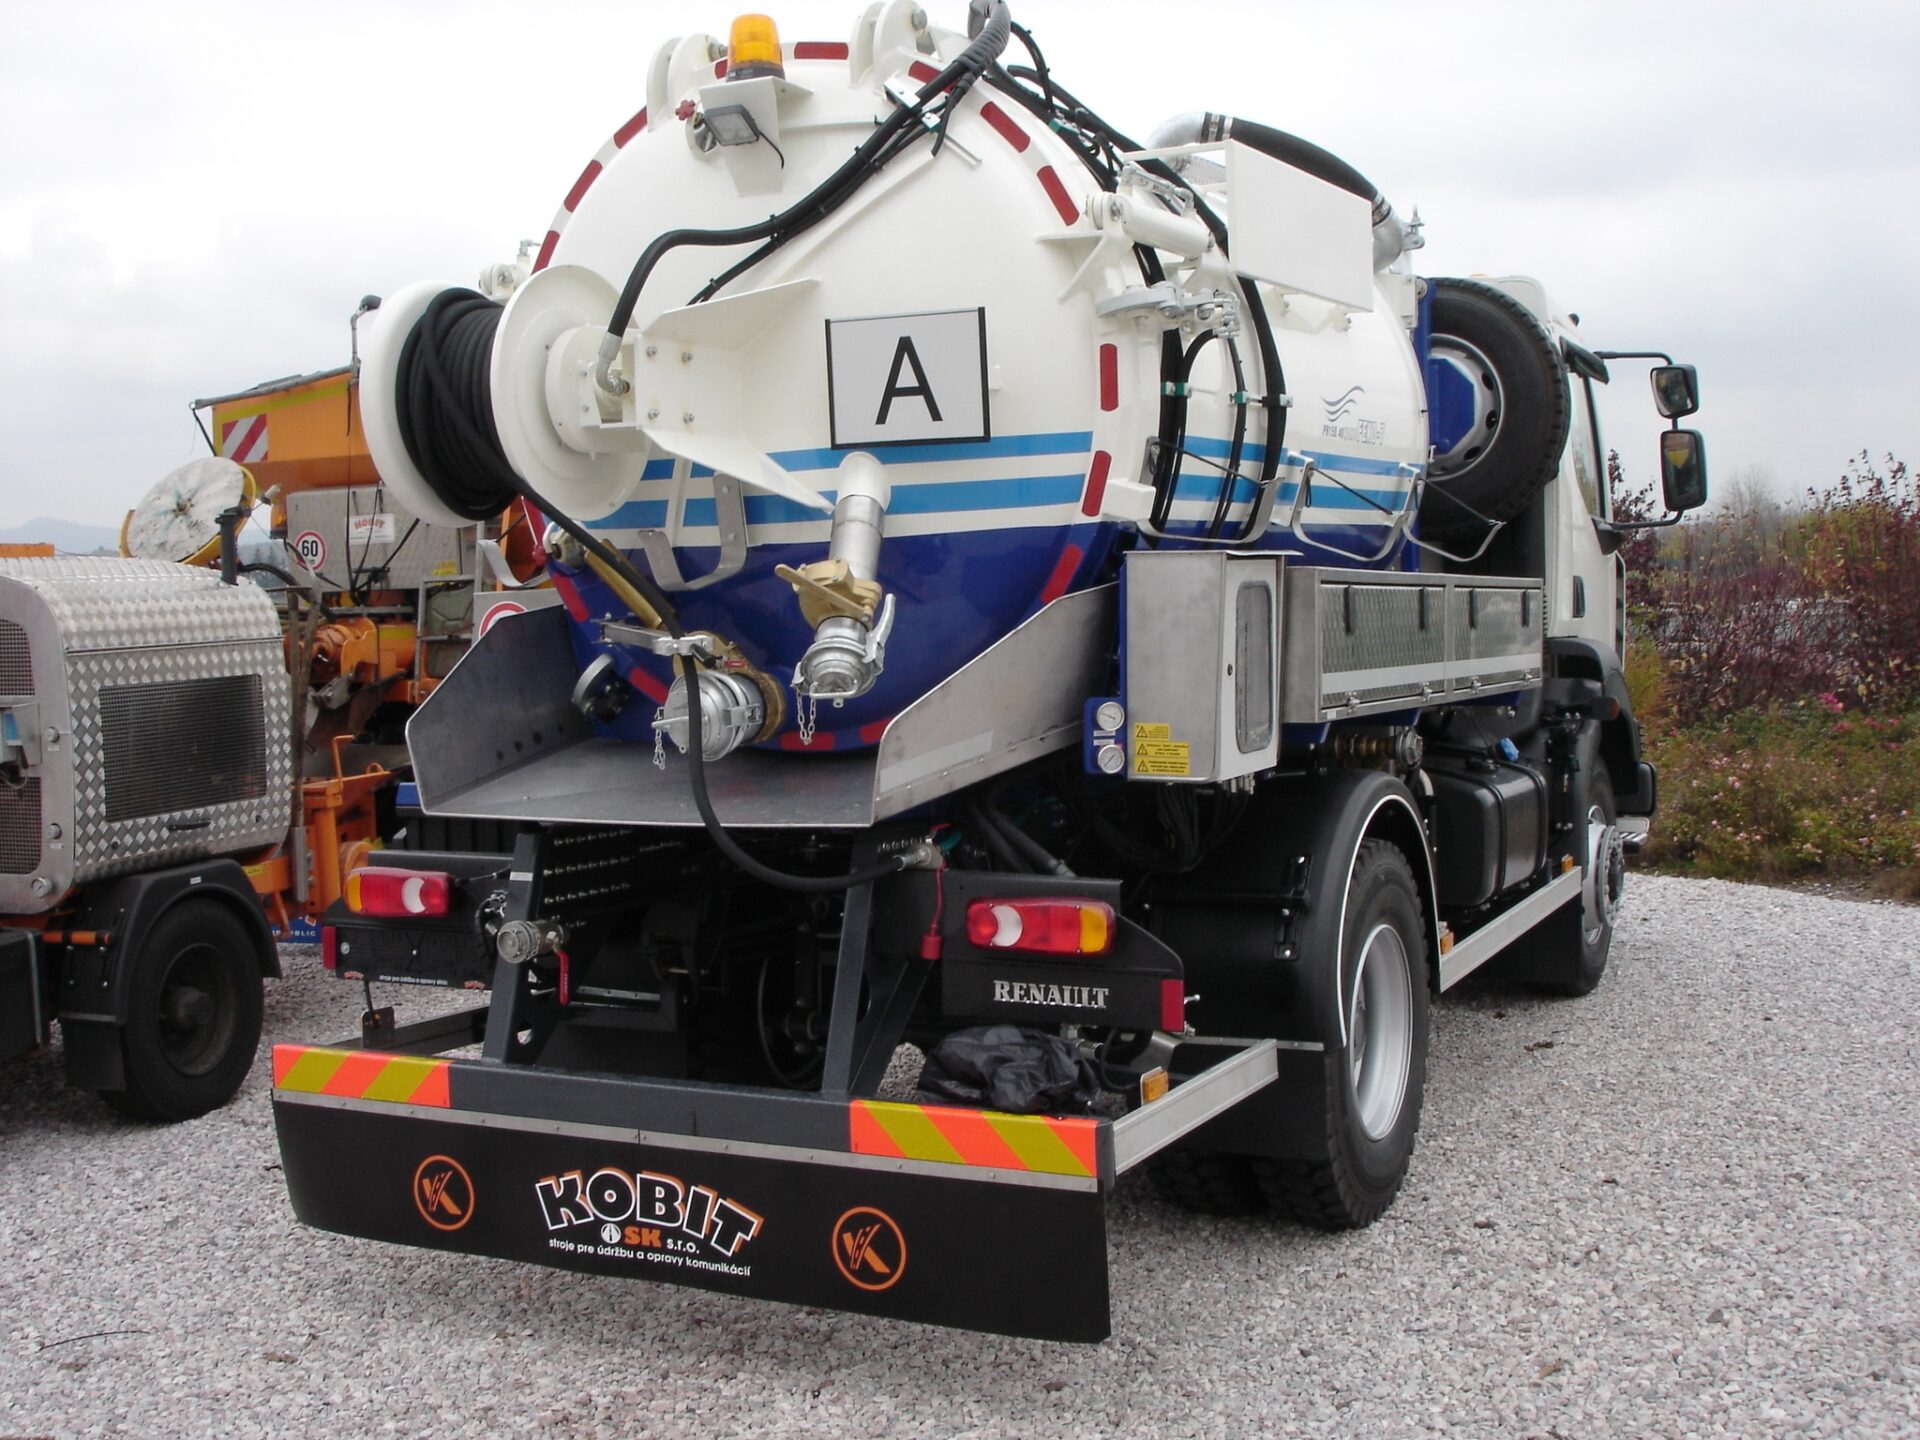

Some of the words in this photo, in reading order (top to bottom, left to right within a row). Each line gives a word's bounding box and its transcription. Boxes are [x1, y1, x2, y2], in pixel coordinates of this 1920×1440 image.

[874, 335, 944, 426] A
[301, 539, 319, 558] 60
[993, 980, 1109, 1009] RENAULT
[535, 1167, 765, 1257] KOBIT
[623, 1225, 662, 1248] SK
[666, 1238, 700, 1254] s.r.o.
[549, 1238, 575, 1252] stroje
[577, 1244, 595, 1254] pre
[597, 1244, 634, 1258] údržbu
[636, 1251, 645, 1260] a
[647, 1252, 684, 1267] opravy
[686, 1256, 752, 1277] komunikácií
